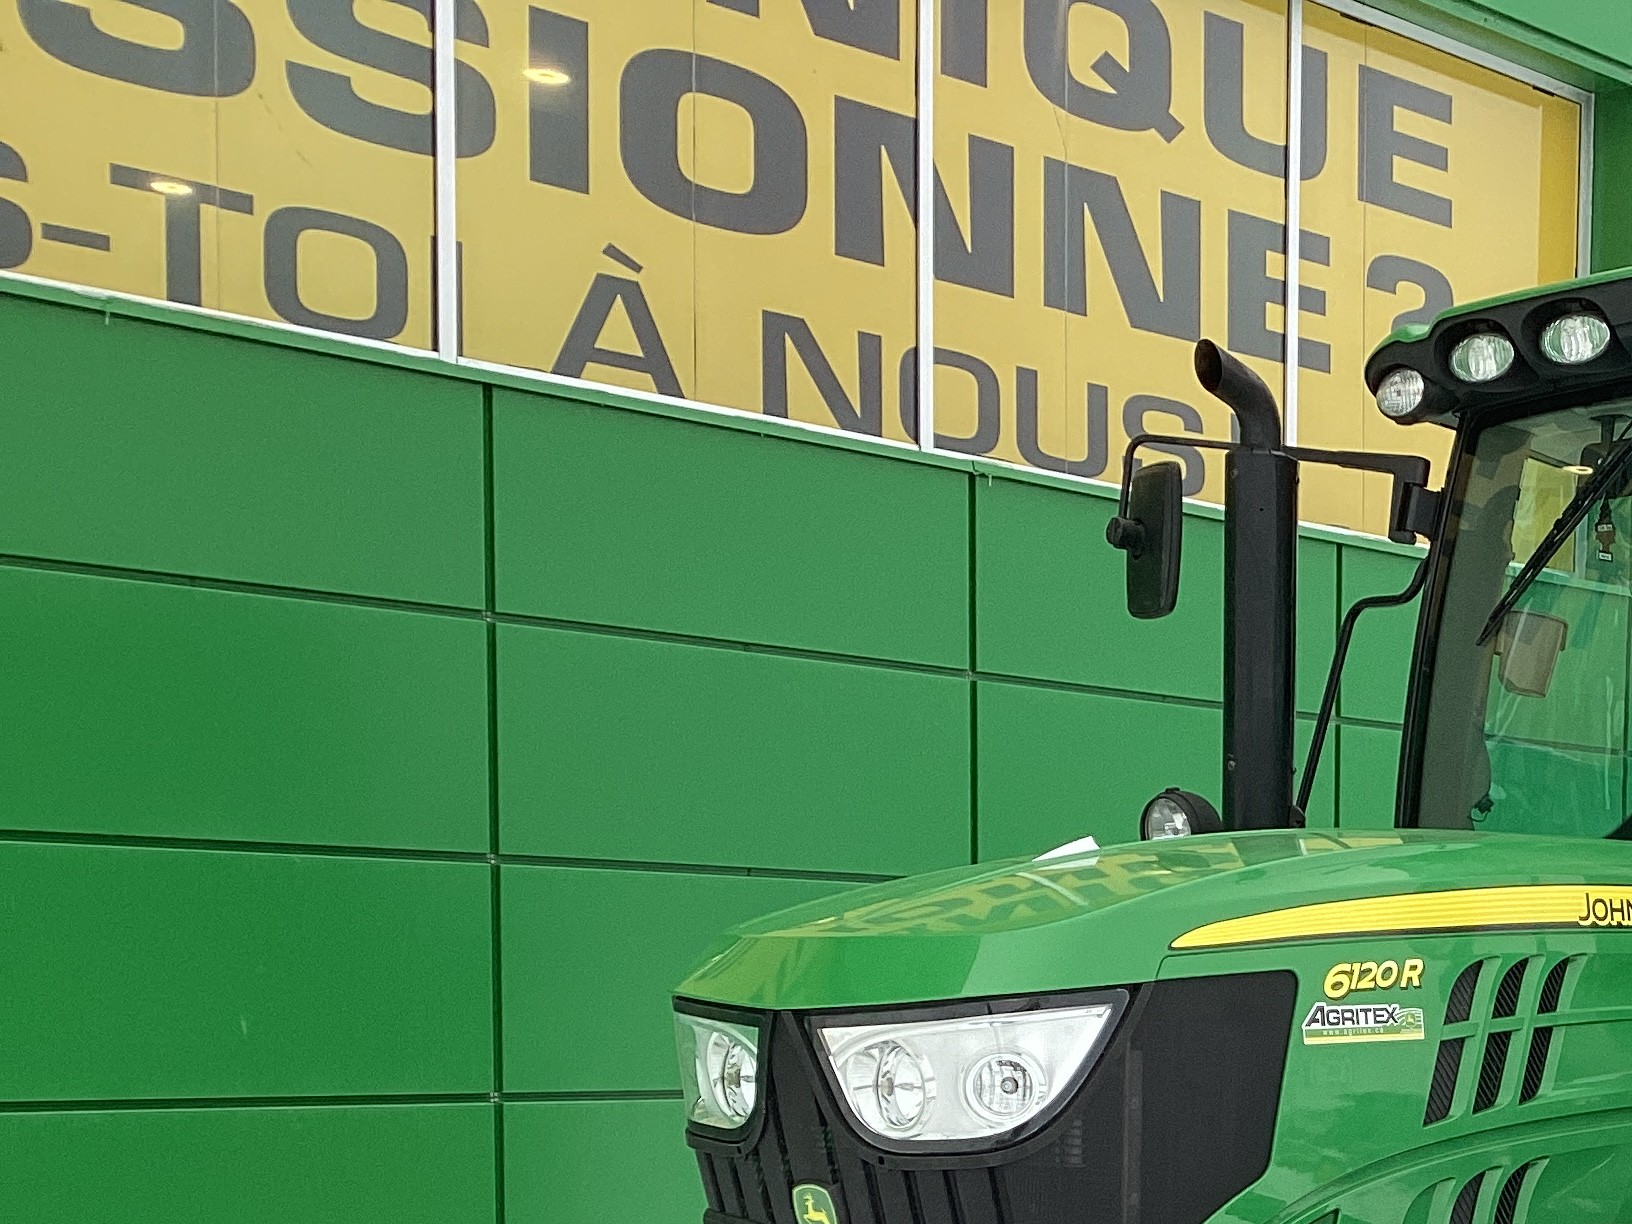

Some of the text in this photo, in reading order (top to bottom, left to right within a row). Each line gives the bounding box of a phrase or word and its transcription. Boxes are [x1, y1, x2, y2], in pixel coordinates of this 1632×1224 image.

[549, 243, 687, 399] À
[761, 309, 1241, 498] NOUS
[1305, 1005, 1399, 1028] AGRITEX
